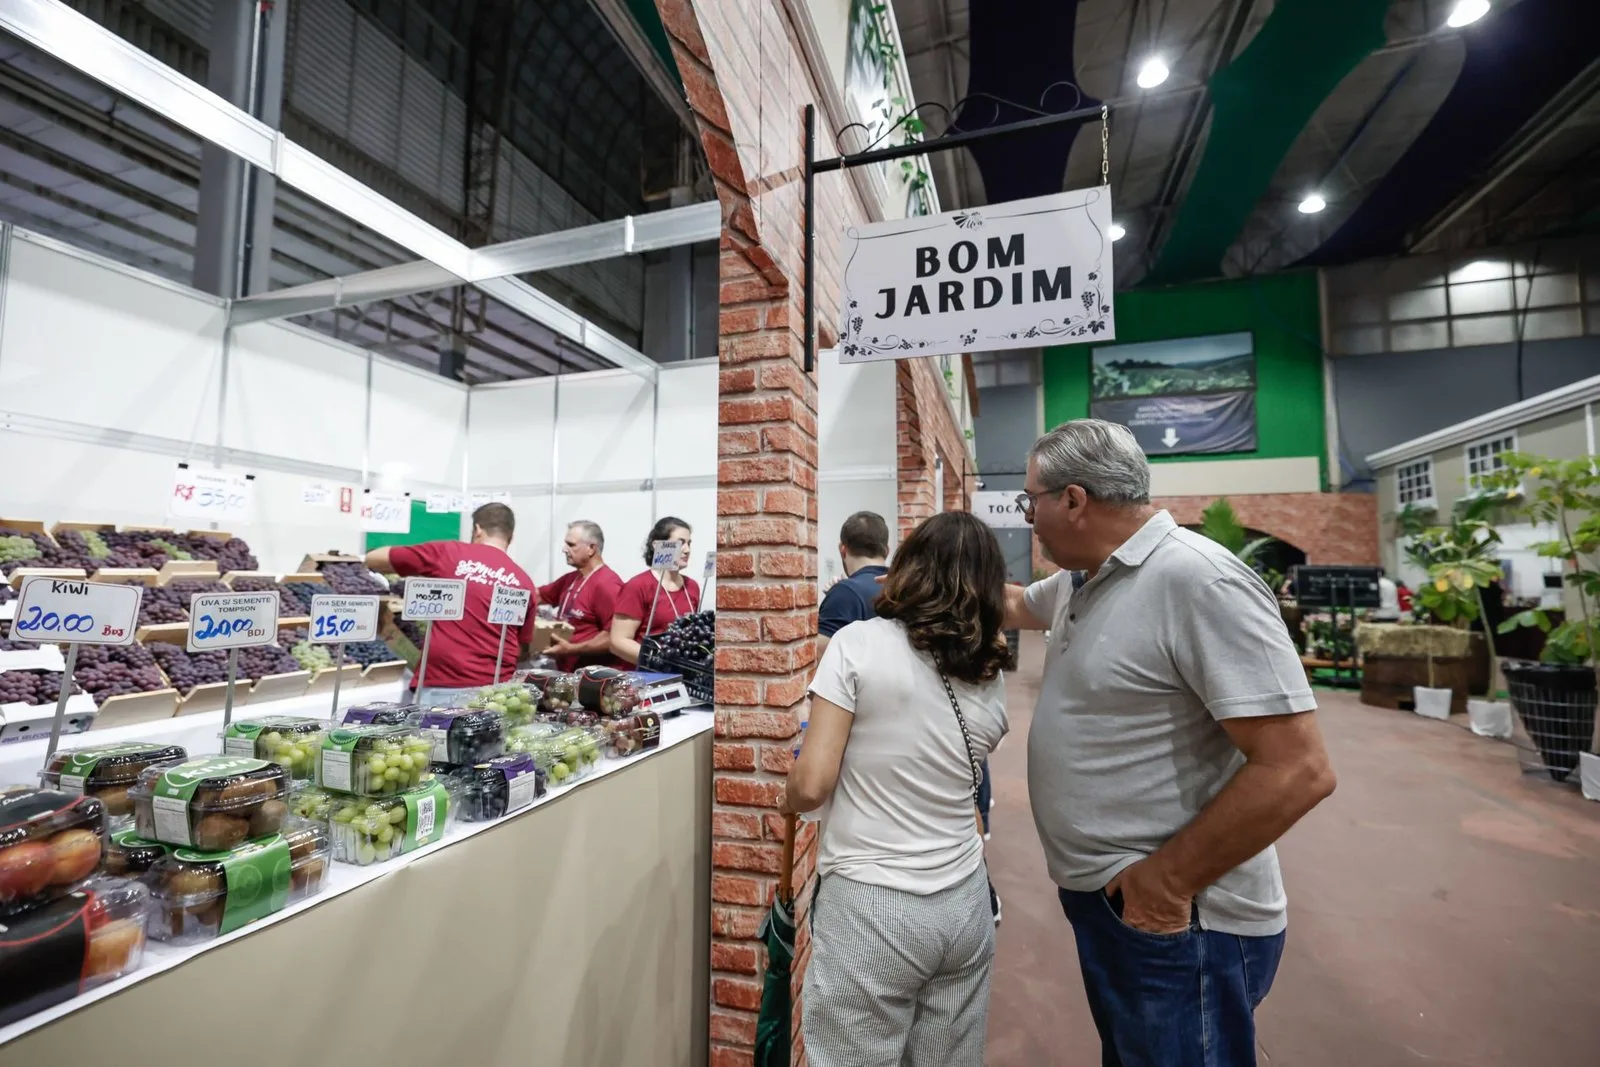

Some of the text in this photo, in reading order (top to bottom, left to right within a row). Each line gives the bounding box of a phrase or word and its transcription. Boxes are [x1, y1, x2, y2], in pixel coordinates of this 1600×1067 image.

[916, 233, 1025, 278] BOM
[875, 266, 1072, 319] JARDIM
[218, 605, 256, 613] TOMPSON
[222, 598, 231, 606] S/
[232, 597, 271, 605] SEMENTE
[17, 606, 94, 633] 20,00
[195, 614, 265, 640] 20,00 BDJ
[315, 614, 355, 637] 15,00
